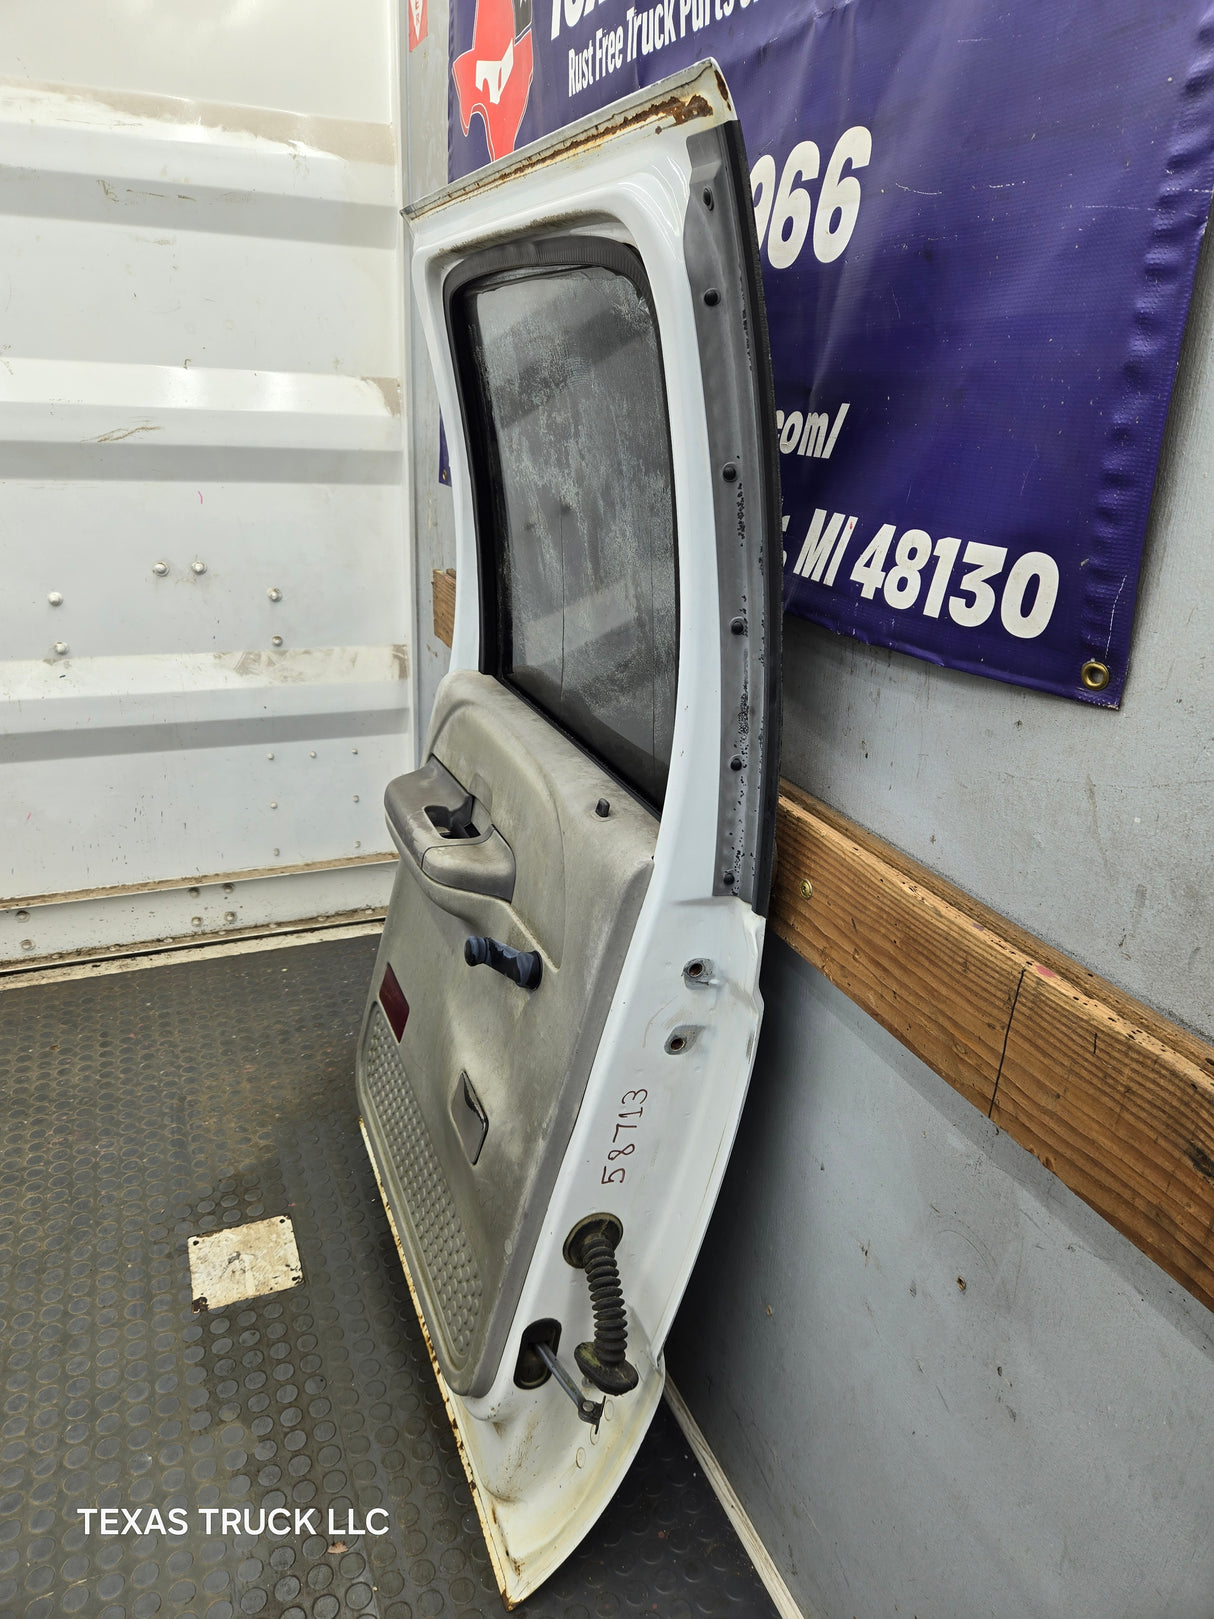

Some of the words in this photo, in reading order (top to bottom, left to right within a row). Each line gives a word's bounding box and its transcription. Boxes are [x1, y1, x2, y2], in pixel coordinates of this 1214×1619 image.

[568, 39, 594, 98] Rust
[595, 26, 624, 81] Free
[626, 0, 677, 62] Truck
[792, 508, 859, 587] MI
[849, 523, 1060, 639] 48130
[601, 1088, 648, 1185] 58713
